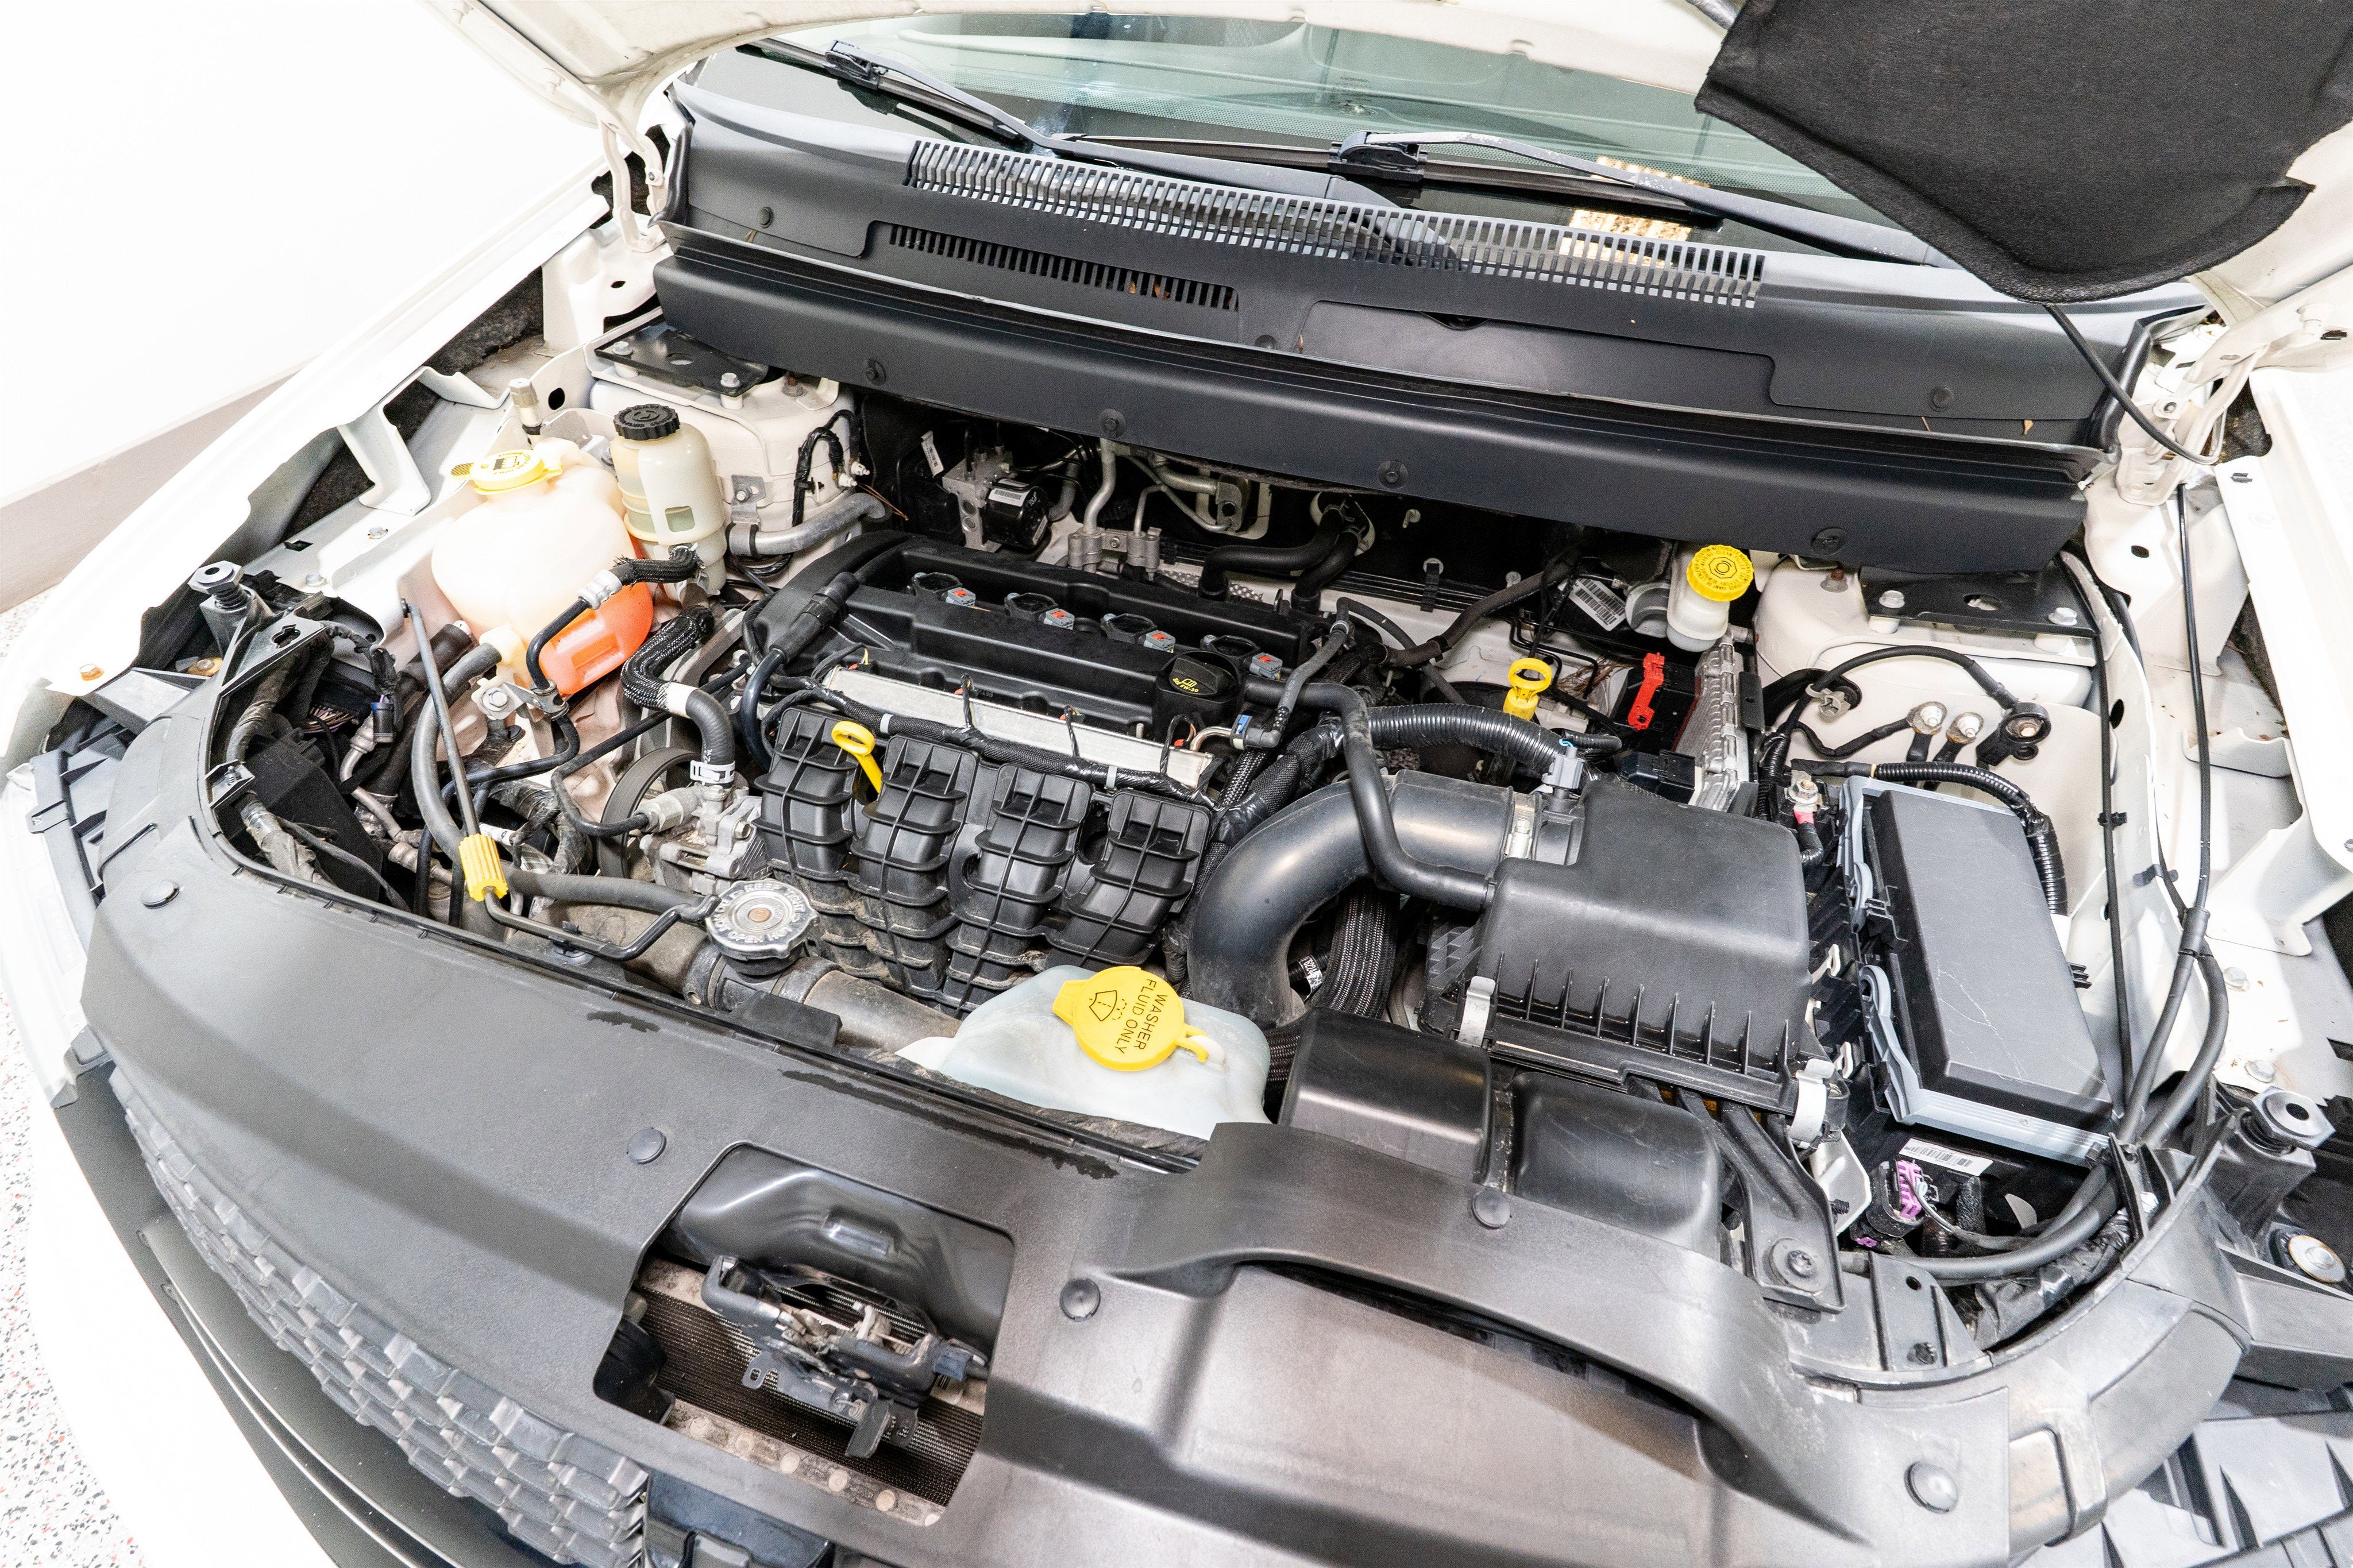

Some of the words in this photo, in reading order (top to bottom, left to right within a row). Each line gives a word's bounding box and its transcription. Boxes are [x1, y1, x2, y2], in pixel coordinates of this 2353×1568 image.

[745, 883, 782, 893] KEEP
[784, 887, 805, 913] TIGHT
[728, 931, 764, 943] OPEN
[767, 927, 792, 941] HOT
[1132, 978, 1157, 1016] FLUID
[1114, 1018, 1138, 1055] ONLY
[1133, 994, 1168, 1051] WASHER
